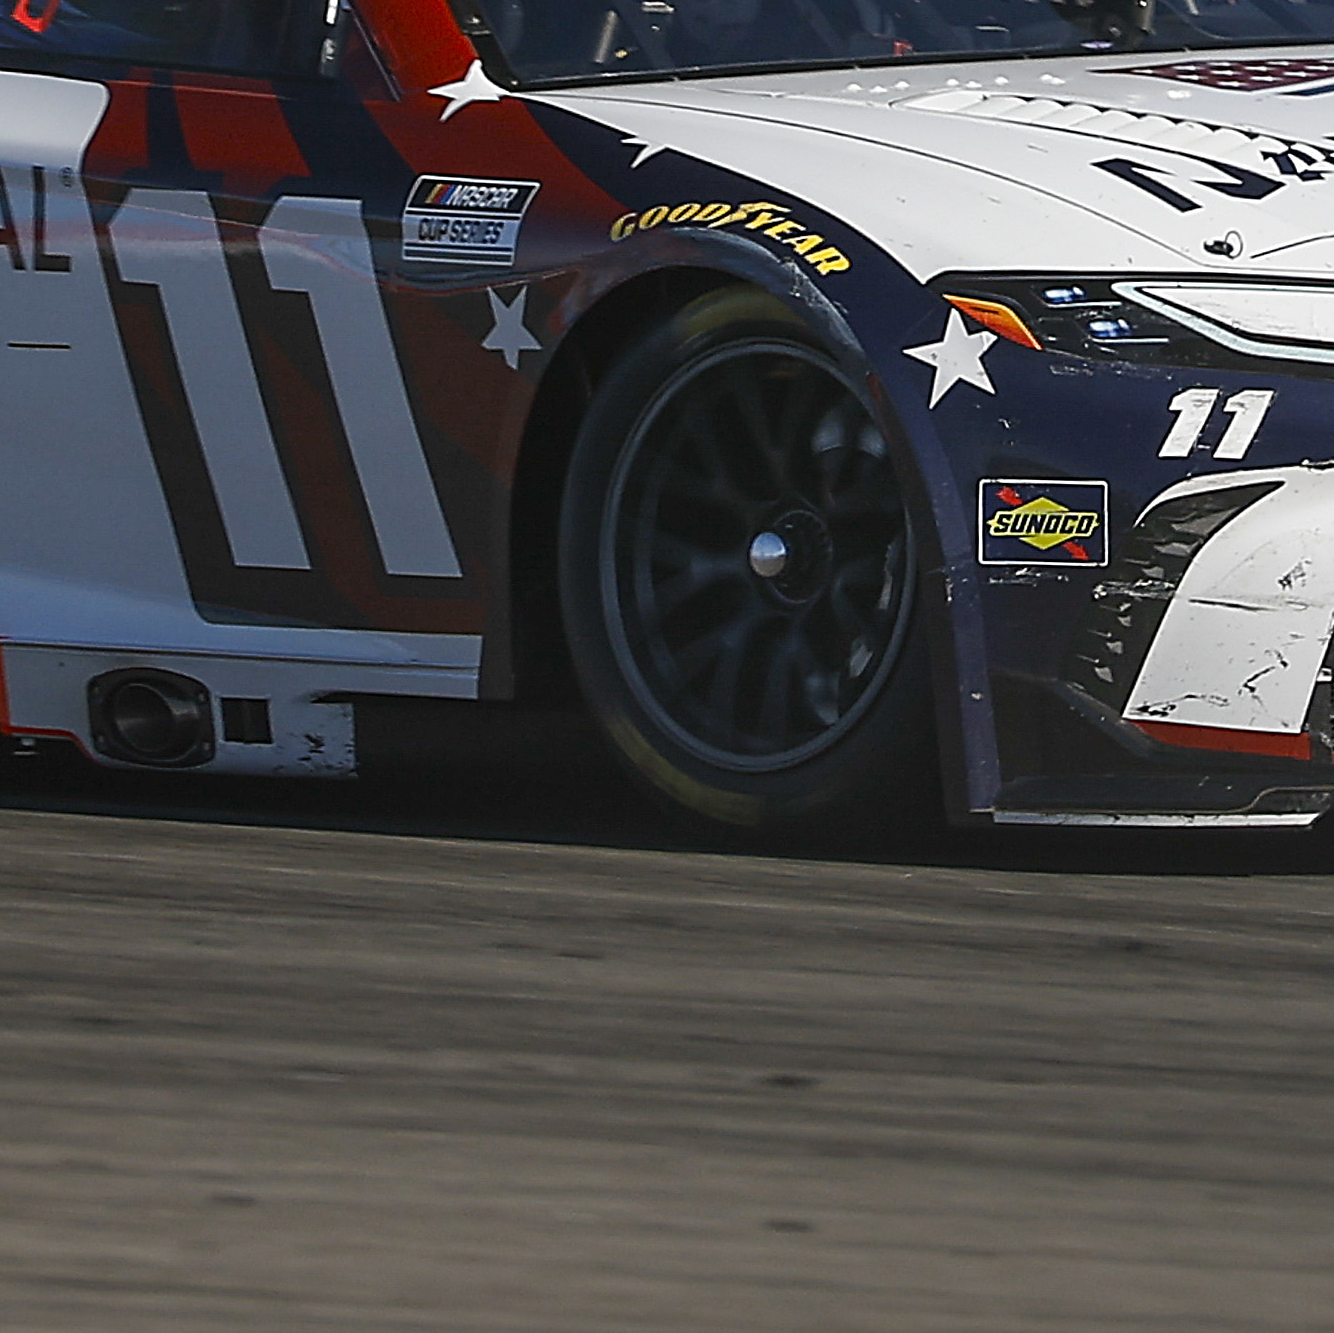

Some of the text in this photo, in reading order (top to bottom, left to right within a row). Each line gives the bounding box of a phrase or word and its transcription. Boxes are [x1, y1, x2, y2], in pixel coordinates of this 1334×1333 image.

[446, 184, 519, 209] NASCAR
[419, 217, 505, 245] CUP SERIES
[609, 201, 852, 276] GOODYEAR
[108, 188, 464, 578] 11
[1157, 388, 1276, 460] 11
[992, 513, 1096, 535] SUNOCO
